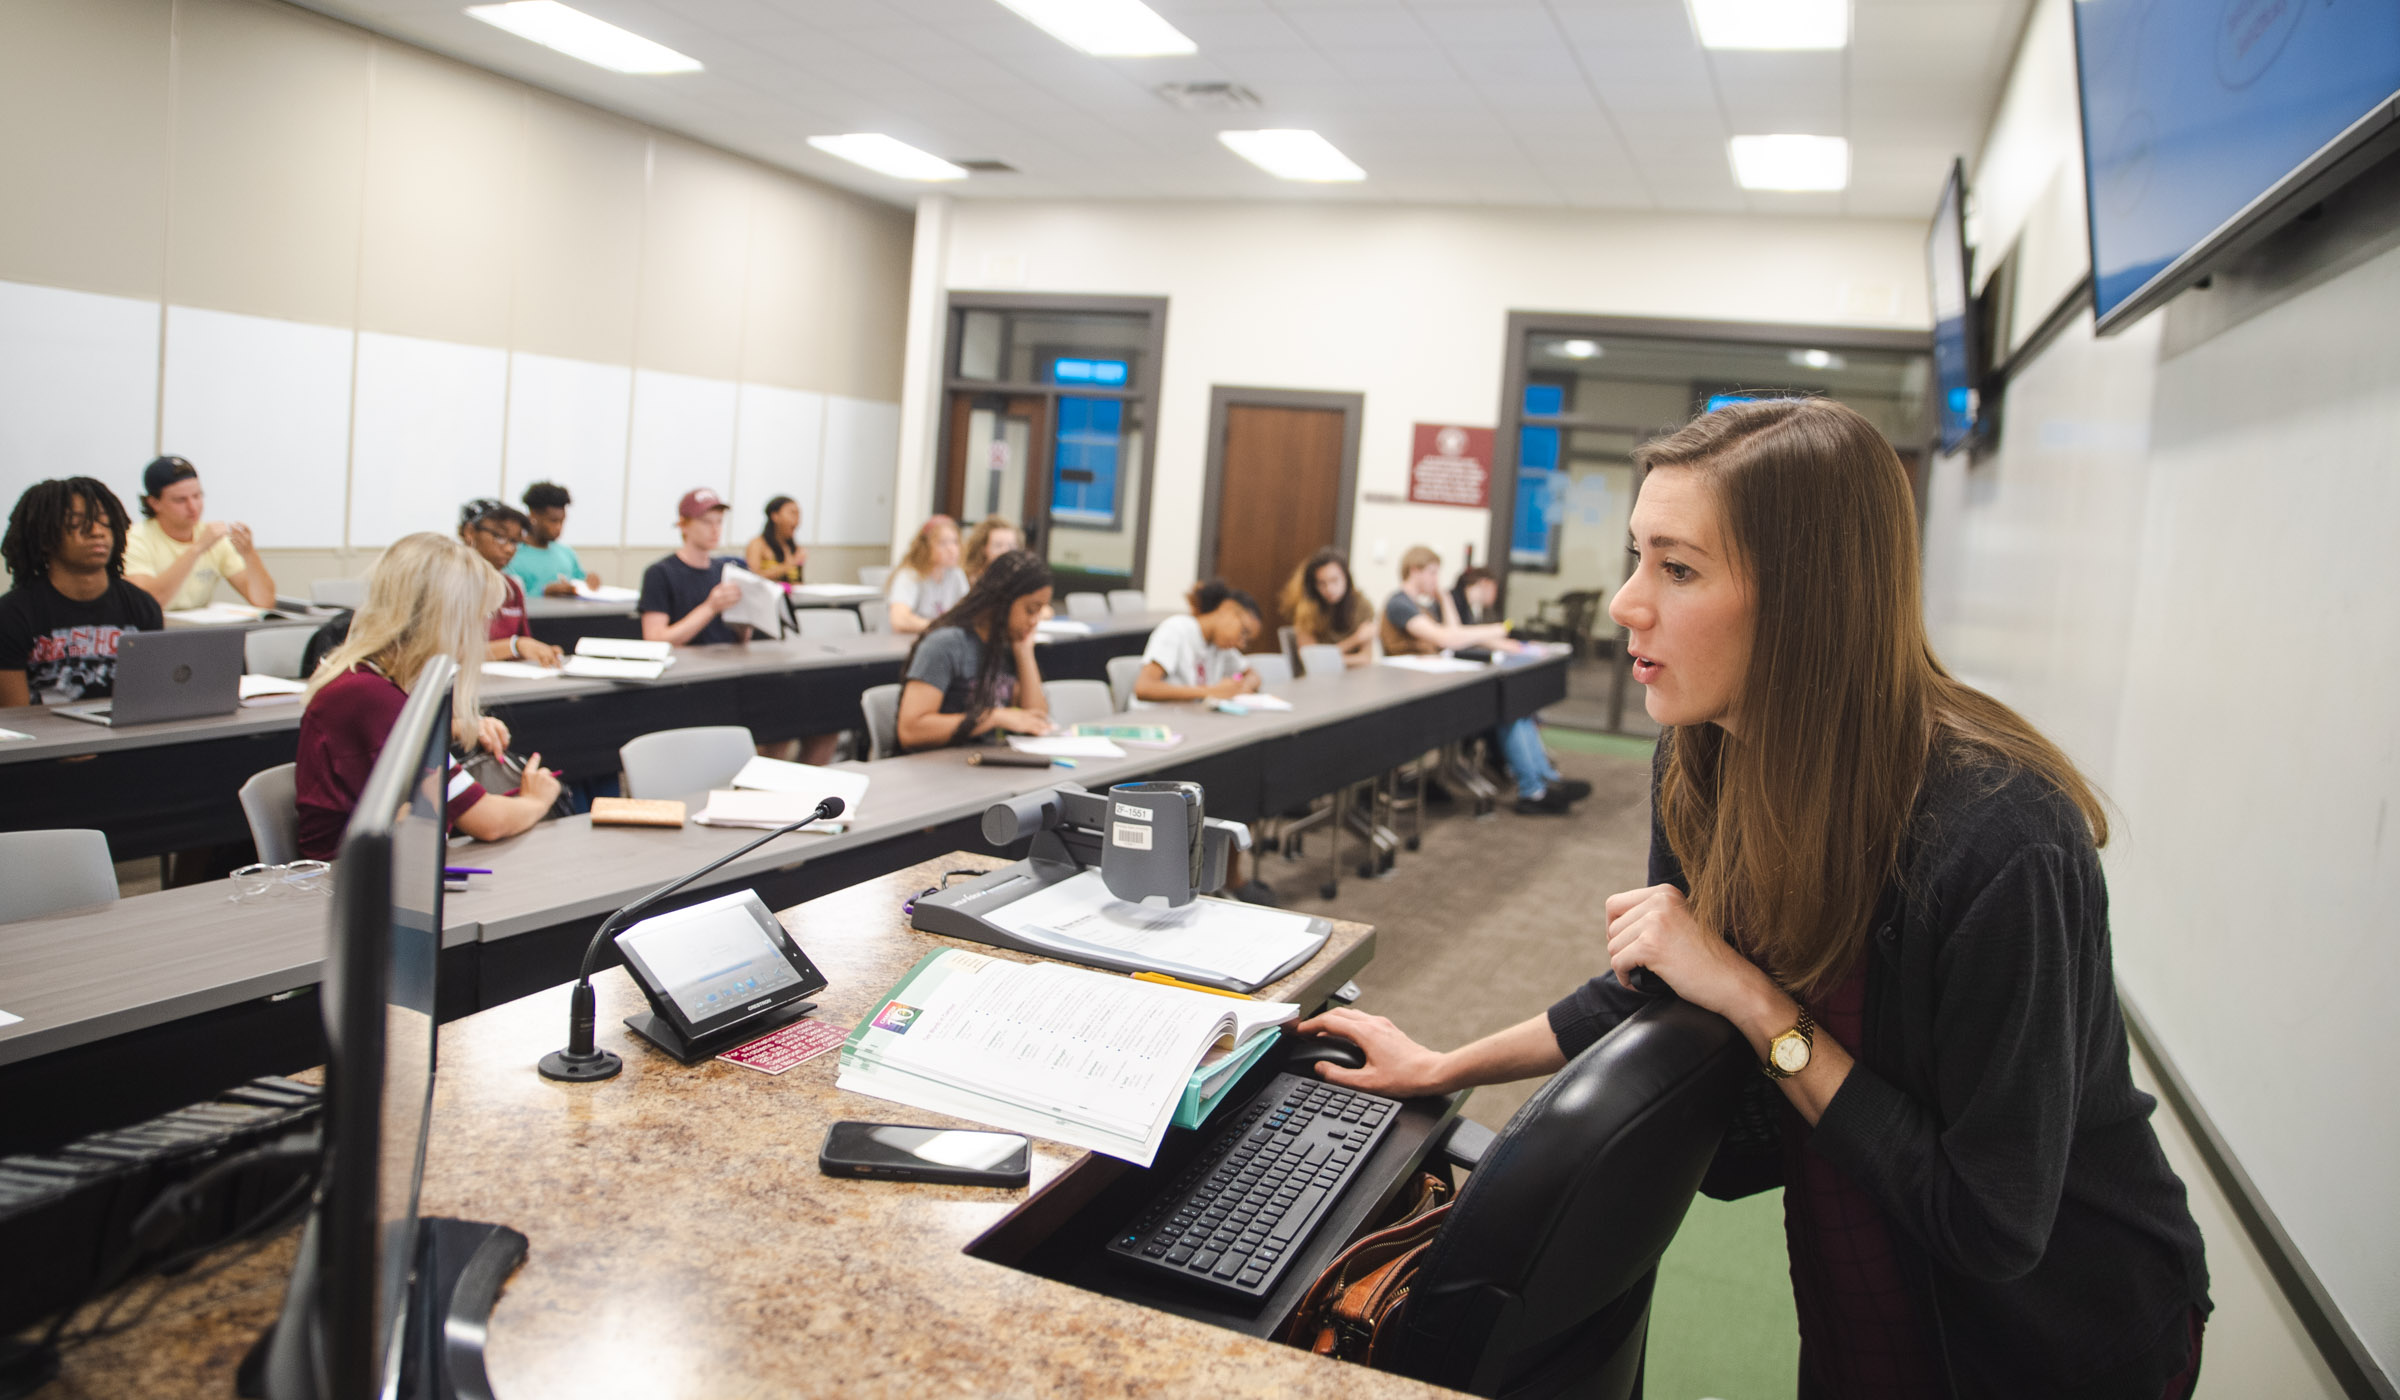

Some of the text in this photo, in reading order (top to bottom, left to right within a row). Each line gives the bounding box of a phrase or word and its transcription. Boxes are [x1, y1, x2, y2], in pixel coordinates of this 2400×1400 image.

[1116, 804, 1147, 818] 2F-1551
[747, 998, 772, 1011] CRESTRON
[888, 1009, 914, 1028] 10
[738, 1036, 779, 1052] Information
[776, 1020, 815, 1036] Technology
[775, 1034, 797, 1044] during
[781, 1036, 807, 1046] Service
